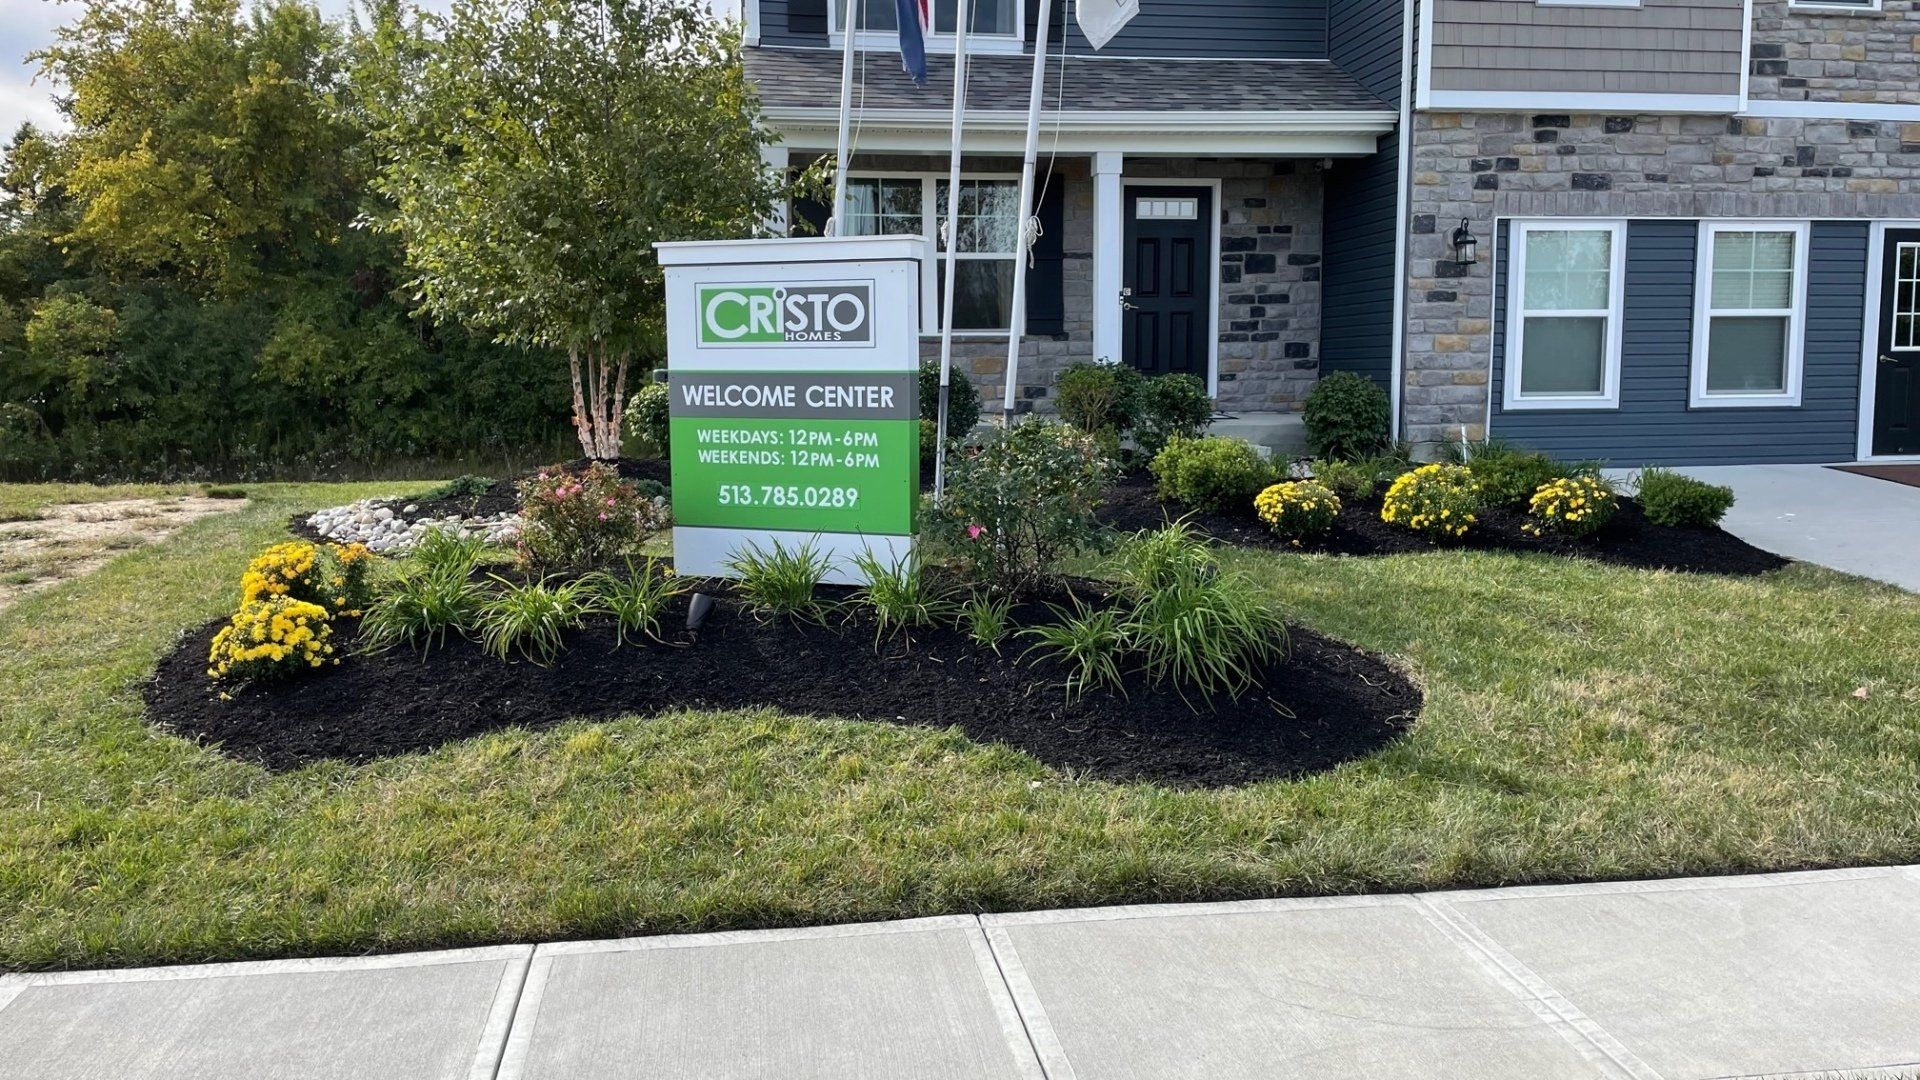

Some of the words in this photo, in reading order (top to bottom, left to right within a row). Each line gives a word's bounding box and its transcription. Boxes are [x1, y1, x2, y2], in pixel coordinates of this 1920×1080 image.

[785, 331, 842, 342] HOMES
[682, 384, 796, 408] WELCOME
[805, 385, 895, 408] CENTER
[697, 429, 784, 445] WEEKDAYS:
[698, 449, 785, 466] WEEKENDS:
[718, 484, 858, 507] 513.785.0289
